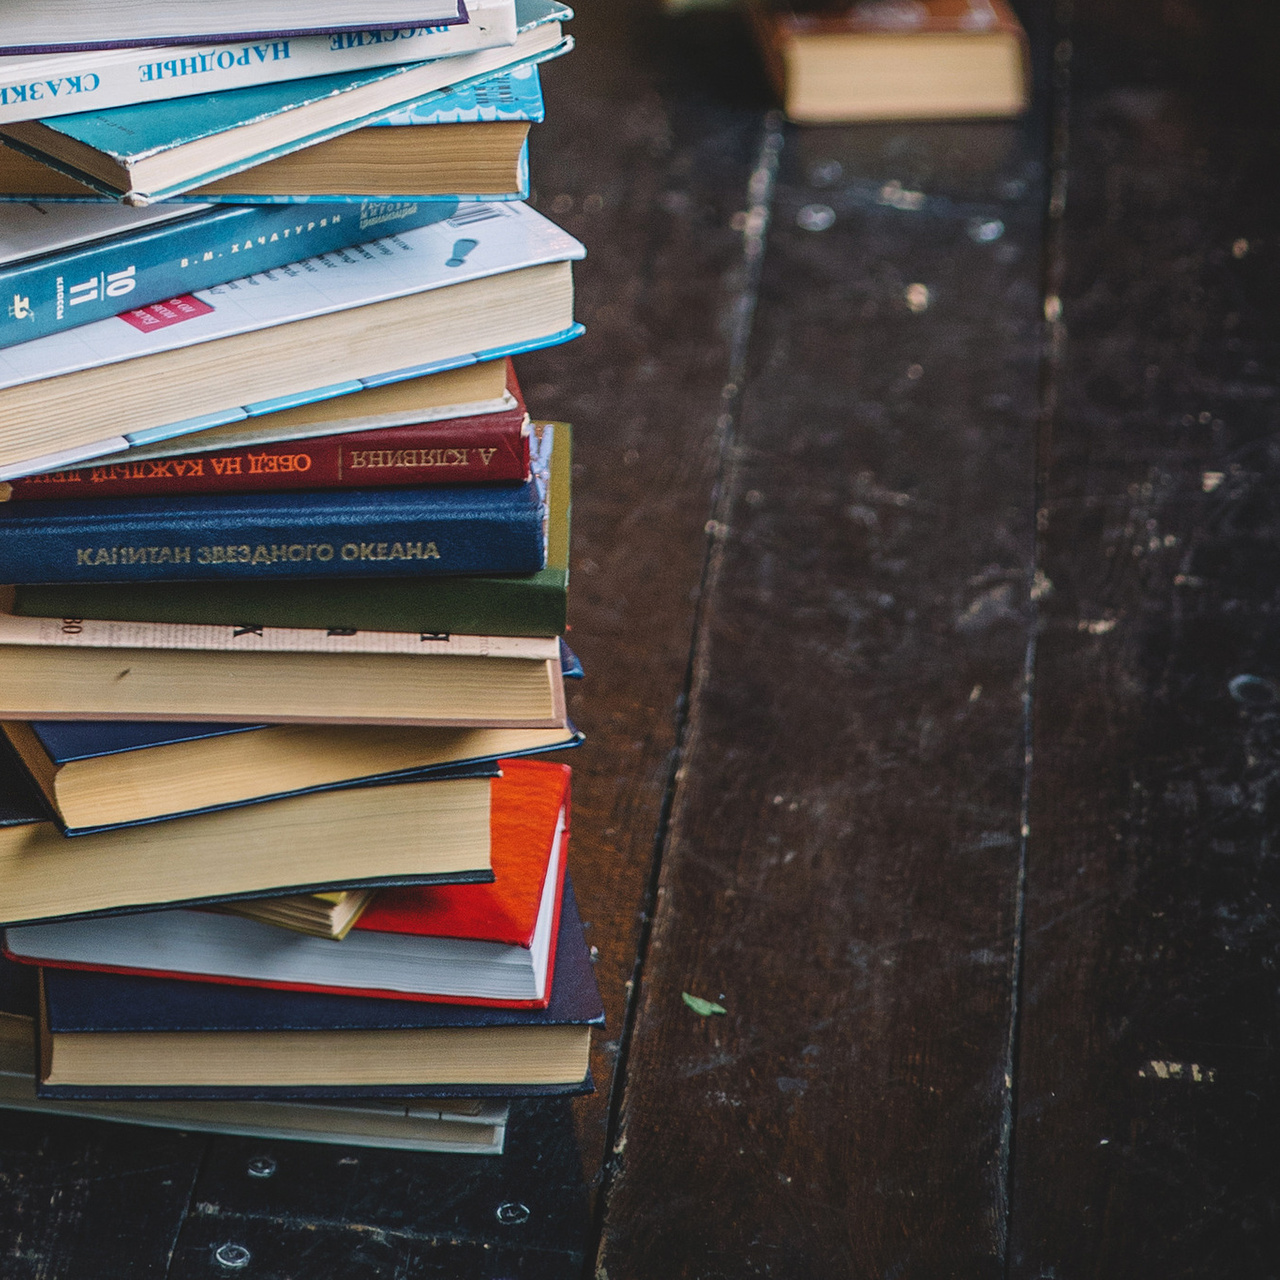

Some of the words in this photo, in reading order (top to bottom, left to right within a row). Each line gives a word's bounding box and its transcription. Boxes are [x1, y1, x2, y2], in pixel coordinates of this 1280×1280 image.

[138, 40, 291, 83] НАРОДНЫЕ
[203, 251, 223, 262] М.
[231, 214, 342, 254] ХАЧАТУРЯН
[70, 277, 98, 306] 11
[107, 265, 136, 297] 10
[211, 457, 242, 475] НА
[248, 452, 312, 474] ОБЕД
[351, 448, 469, 469] КЛЯВИНЯ
[472, 448, 498, 466] А.
[91, 459, 204, 483] КАЖДЫЙ
[76, 546, 191, 566] КАПИТАН
[197, 544, 334, 566] ЗВЕЗДНОГО
[340, 541, 441, 561] ОКЕАНА
